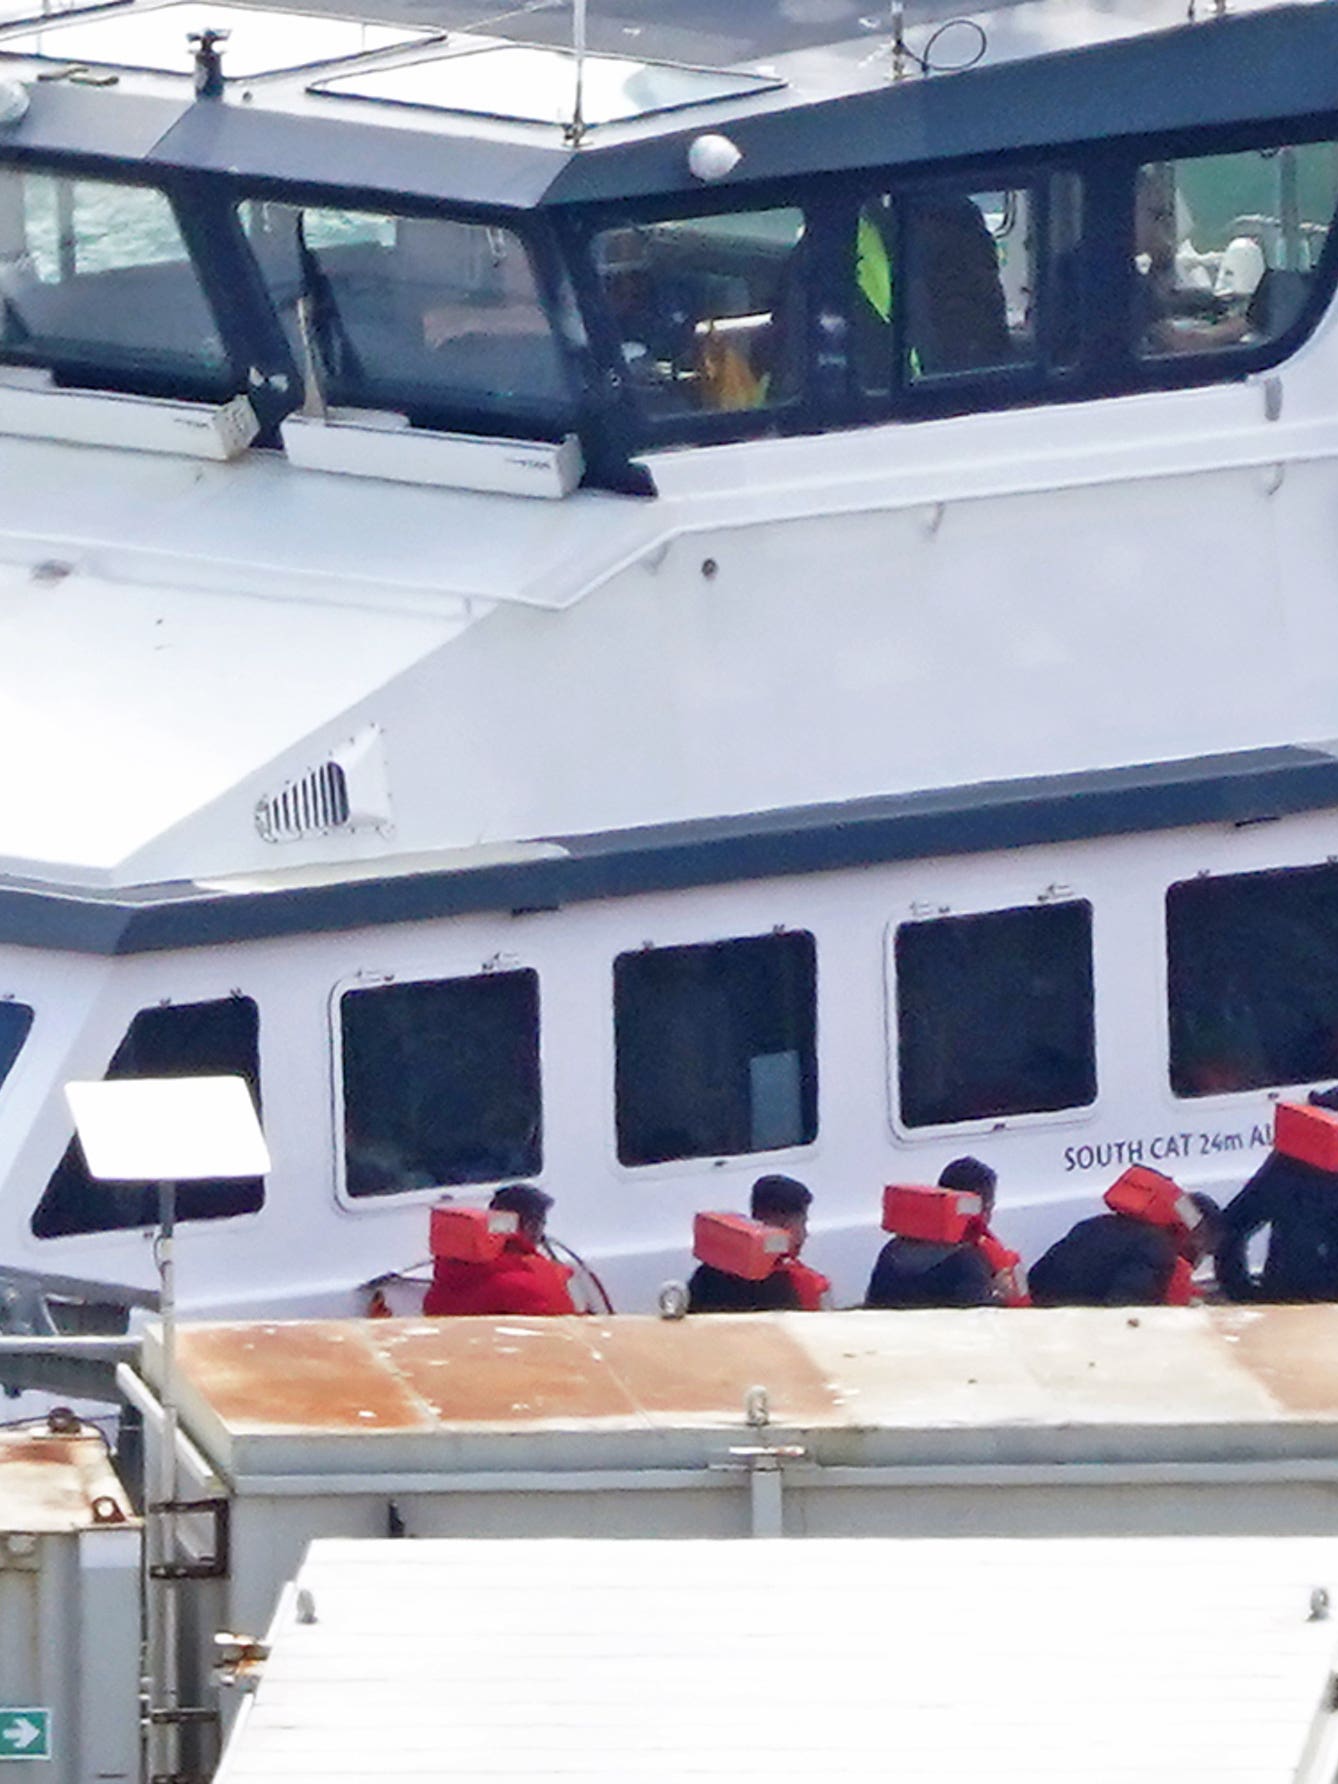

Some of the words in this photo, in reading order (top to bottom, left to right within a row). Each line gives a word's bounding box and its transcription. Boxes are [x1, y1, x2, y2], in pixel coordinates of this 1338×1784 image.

[1065, 1140, 1143, 1172] SOUTH
[1150, 1133, 1193, 1159] CAT
[1200, 1132, 1243, 1154] 24m
